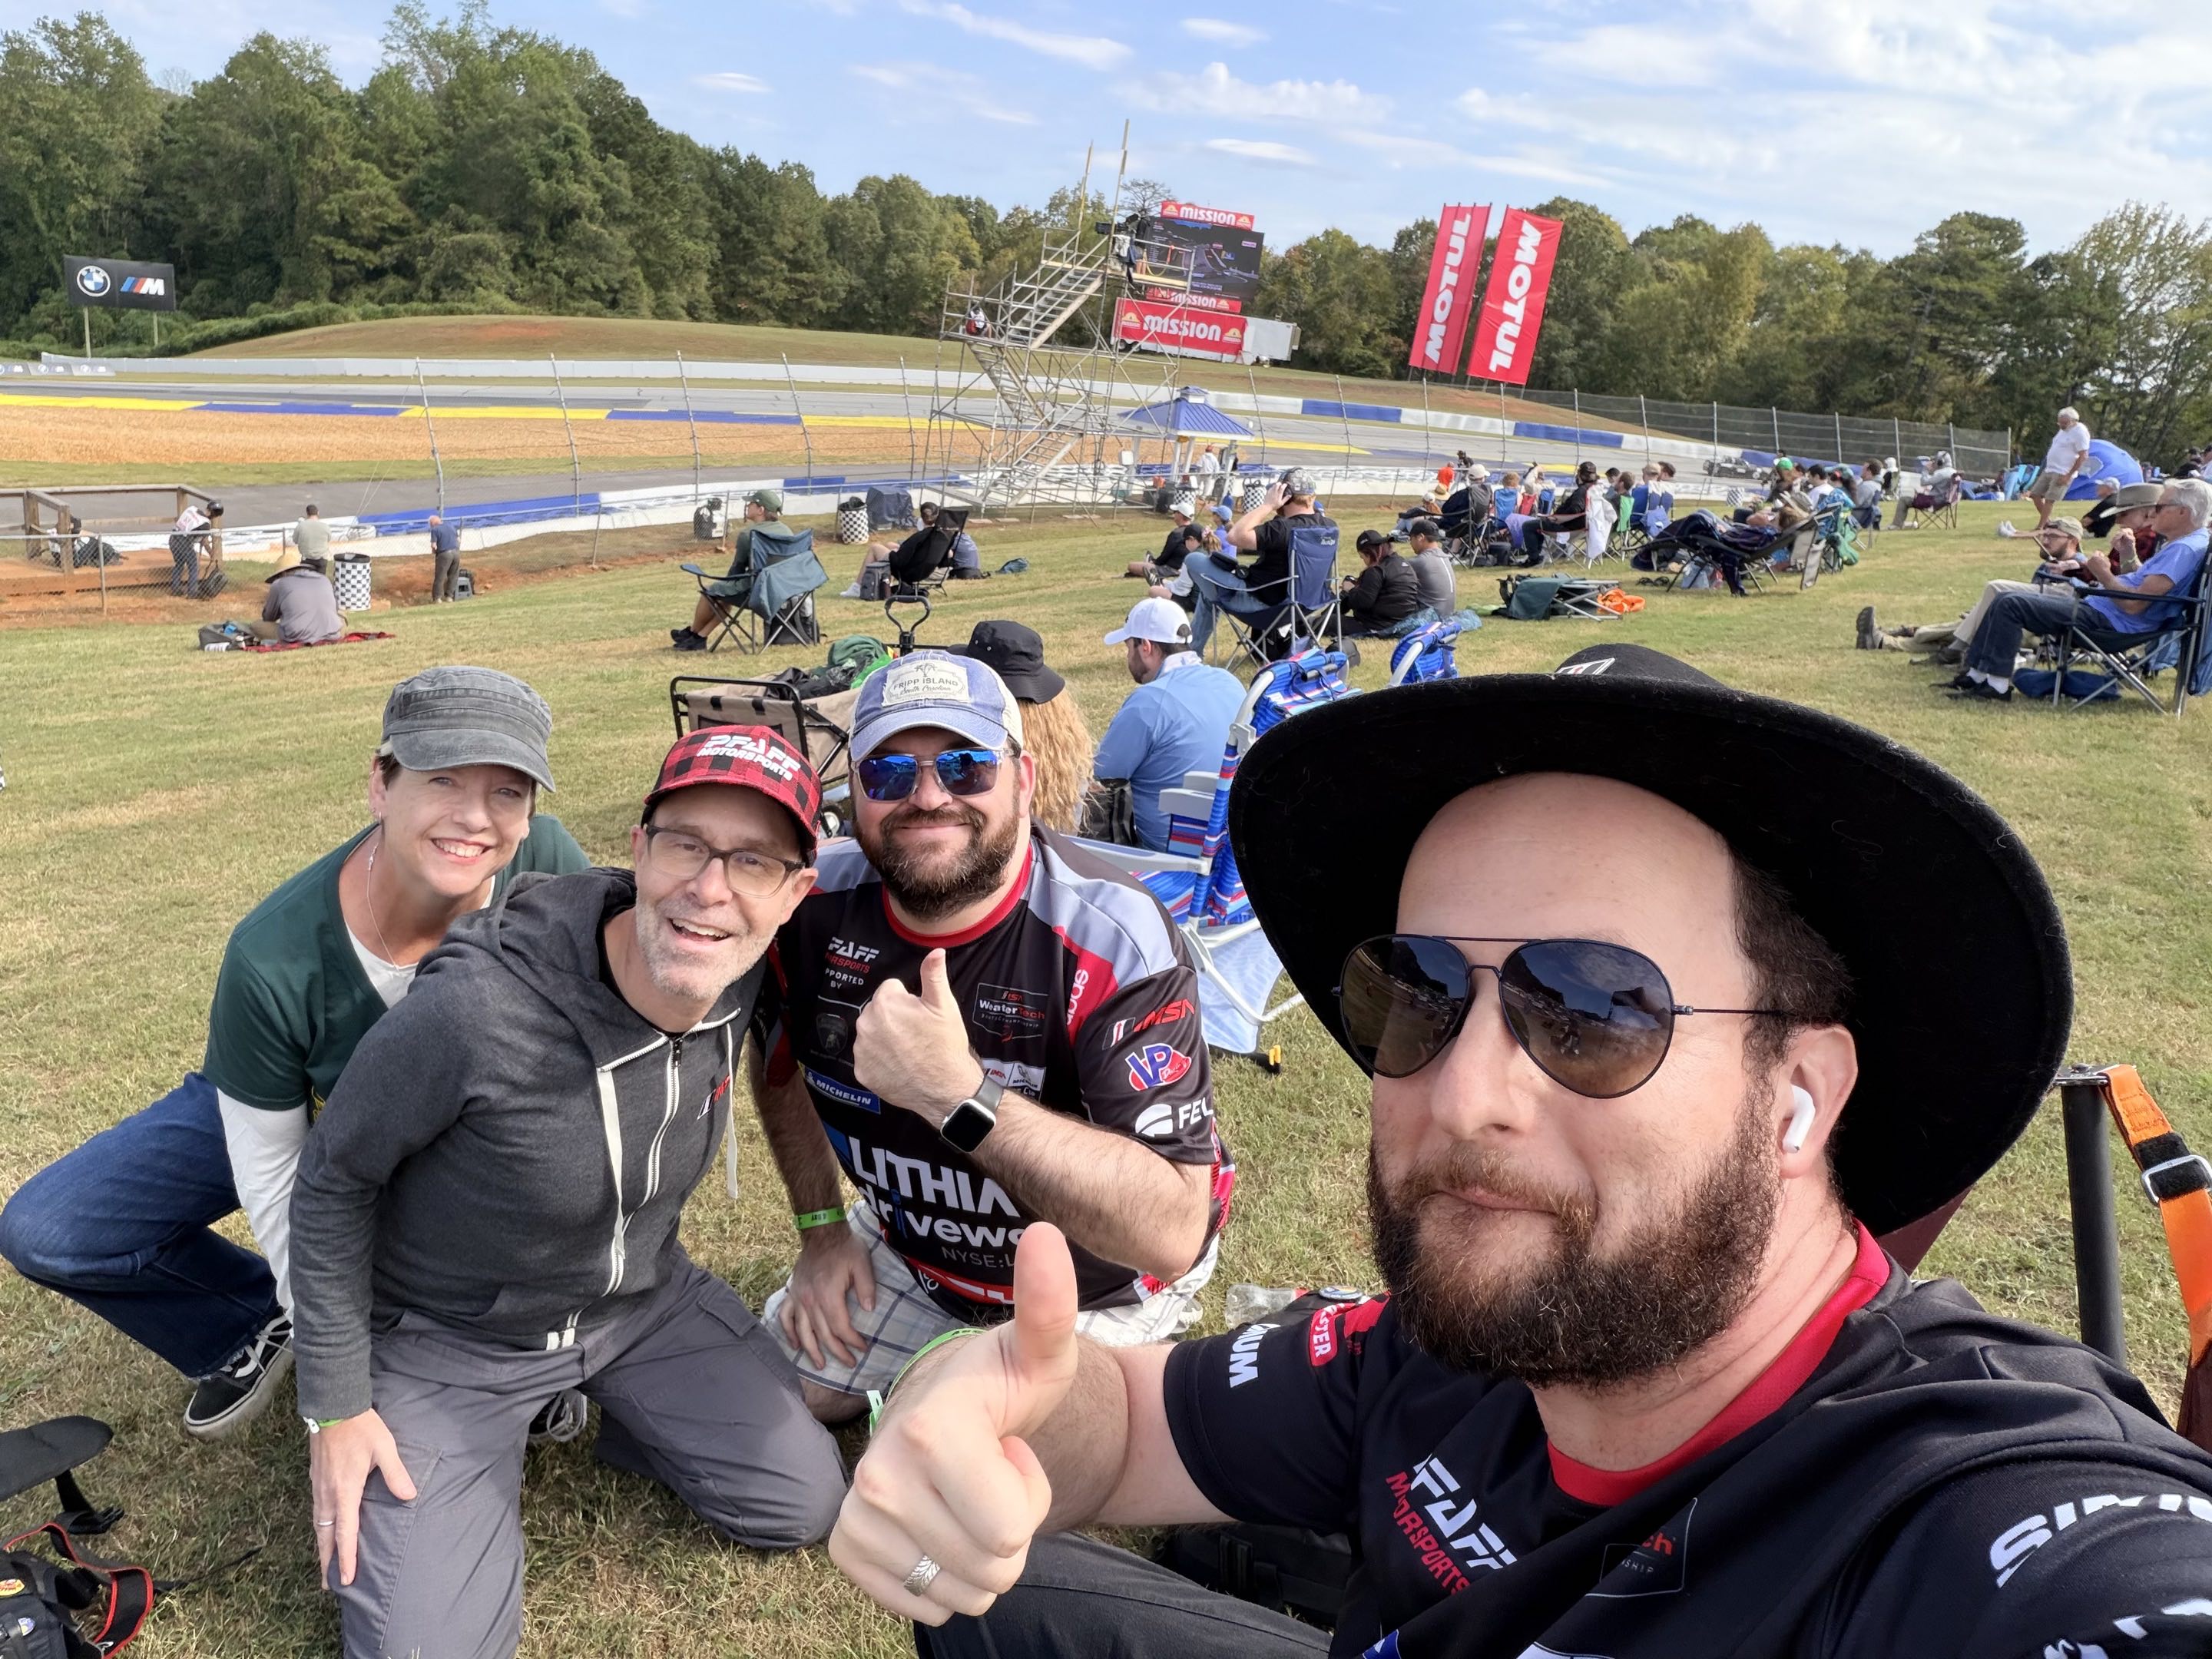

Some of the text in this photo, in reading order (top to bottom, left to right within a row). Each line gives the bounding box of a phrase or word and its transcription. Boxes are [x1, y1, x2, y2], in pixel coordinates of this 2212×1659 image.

[1425, 213, 1472, 365] MOTUL
[1488, 220, 1542, 373] MOTUL
[893, 677, 959, 690] FRIPP ISLAND
[900, 685, 919, 695] South
[696, 747, 793, 781] MOTORSPORTS
[703, 734, 801, 772] PFAFF
[828, 936, 879, 962] FAFF
[825, 968, 864, 985] PPORTED
[830, 980, 843, 990] BY
[1066, 969, 1089, 1026] spar
[1133, 998, 1195, 1033] IMSA
[1124, 1042, 1174, 1089] VP
[816, 1079, 872, 1105] MICHELIN
[1178, 1098, 1214, 1129] FEL
[848, 1135, 1021, 1218] LITHIA
[940, 1245, 1015, 1269] NYSE:L
[1313, 1303, 1345, 1358] ASTER
[1410, 1454, 1518, 1570] FAFF
